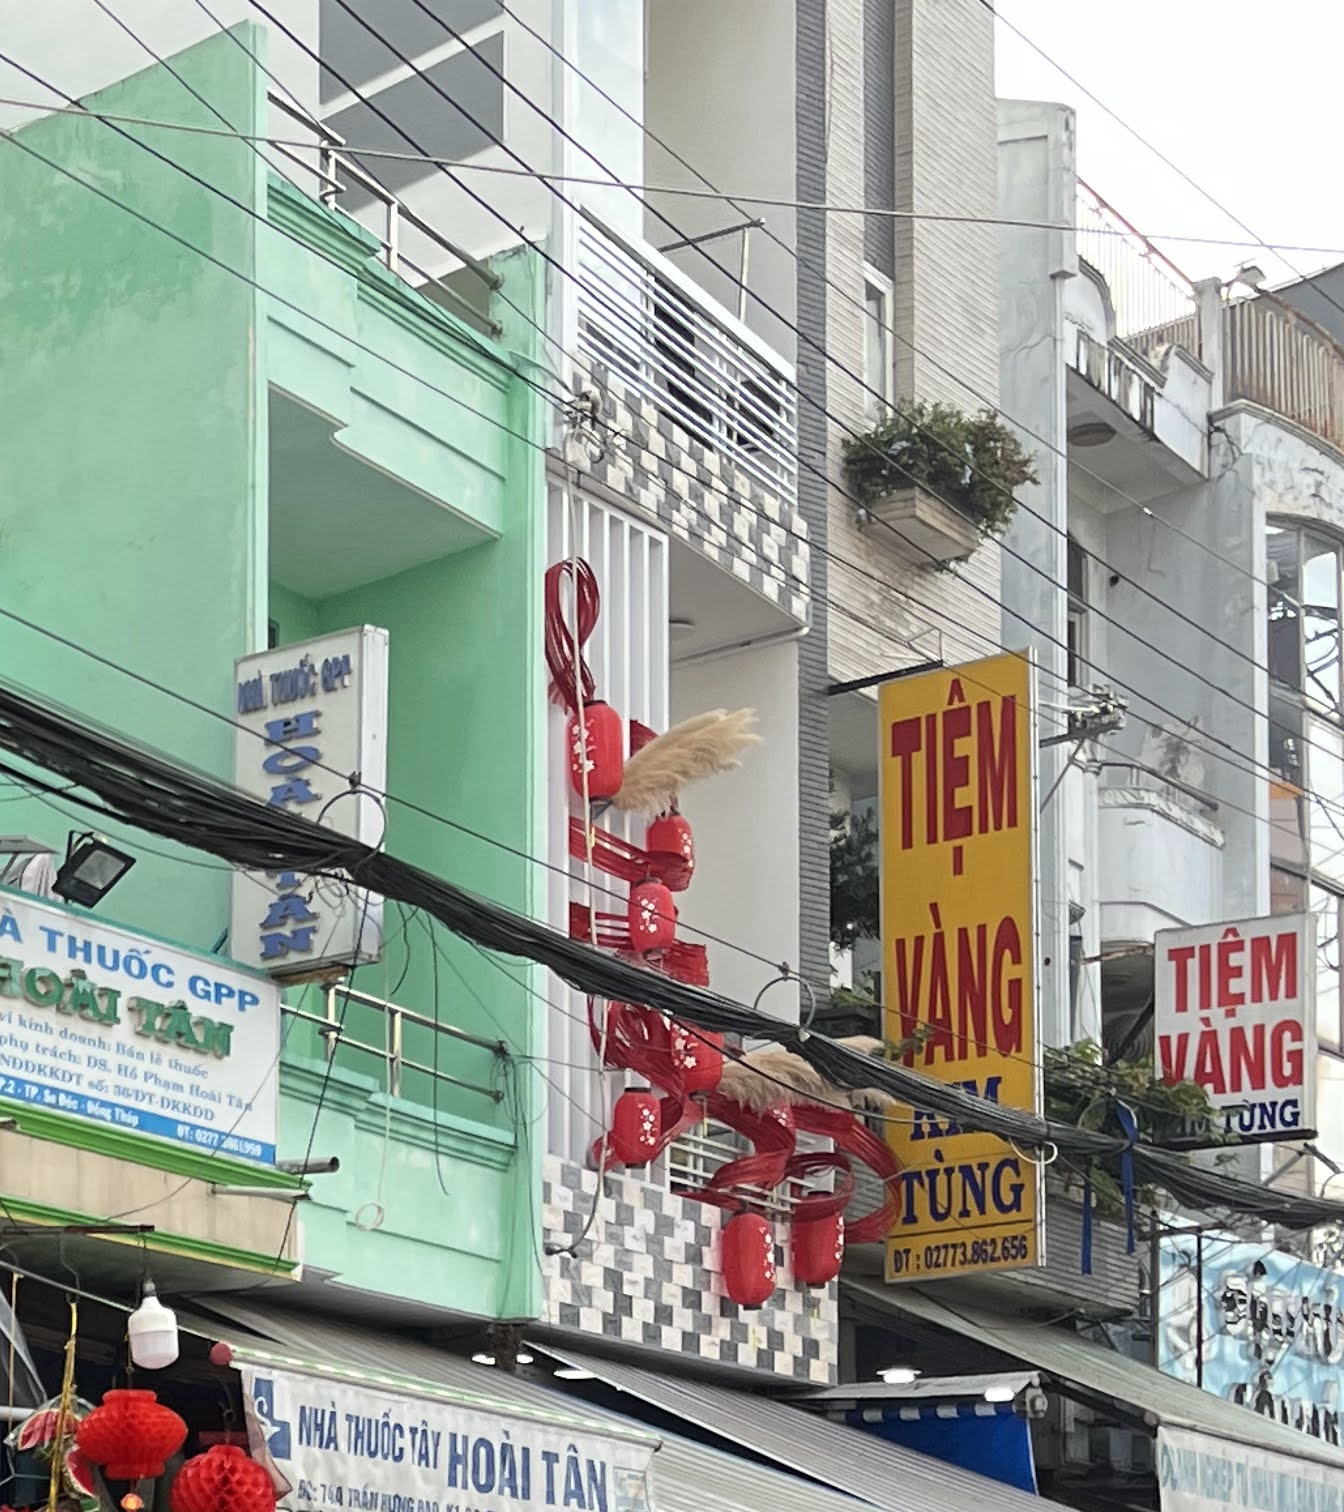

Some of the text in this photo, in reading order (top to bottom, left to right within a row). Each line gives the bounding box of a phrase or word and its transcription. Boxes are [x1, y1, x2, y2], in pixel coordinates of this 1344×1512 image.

[891, 677, 1018, 876] TIỆM
[40, 925, 176, 990] THUỐC
[189, 974, 260, 1013] GPP
[895, 901, 1024, 1069] VÀNG
[1167, 926, 1298, 1019] TIỆM
[17, 1013, 54, 1036] kinh
[168, 1055, 209, 1080] thuốc
[128, 995, 236, 1061] TÂN
[1158, 1016, 1305, 1095] VÀNG
[143, 1070, 184, 1095] Phạm
[902, 1154, 1025, 1227] TÙNG
[298, 1402, 609, 1512] NHÀ THUỐC TÂY HOÀI TÂN
